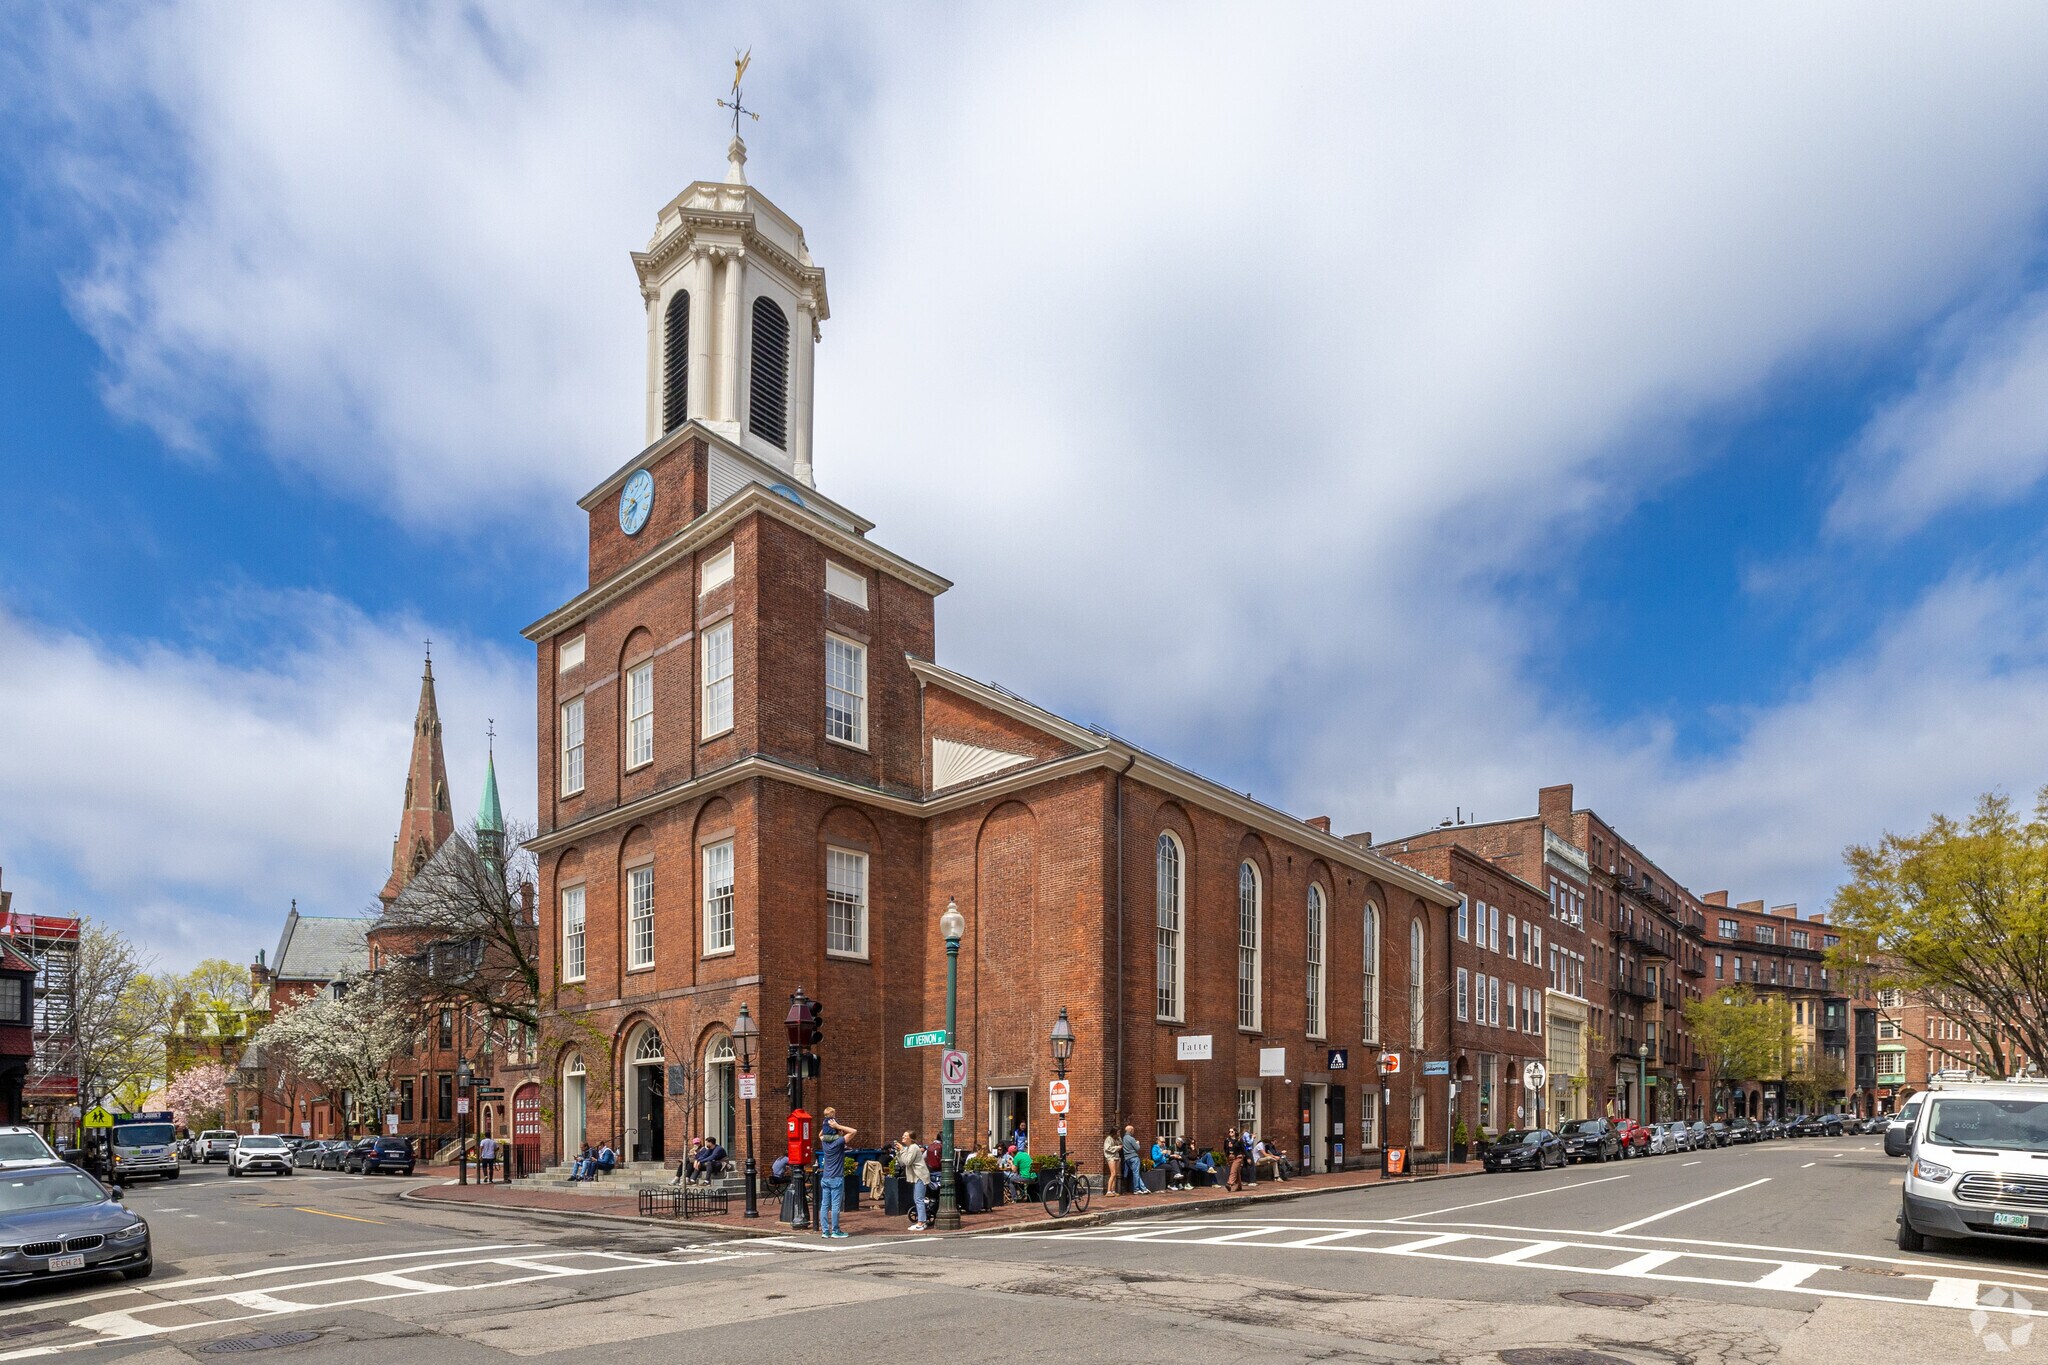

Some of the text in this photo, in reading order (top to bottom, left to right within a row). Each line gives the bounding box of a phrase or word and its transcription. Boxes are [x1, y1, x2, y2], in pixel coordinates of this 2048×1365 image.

[907, 1036, 914, 1046] MT
[915, 1034, 937, 1045] VERNON
[1180, 1042, 1208, 1051] Tatte
[946, 1101, 961, 1109] BUSES
